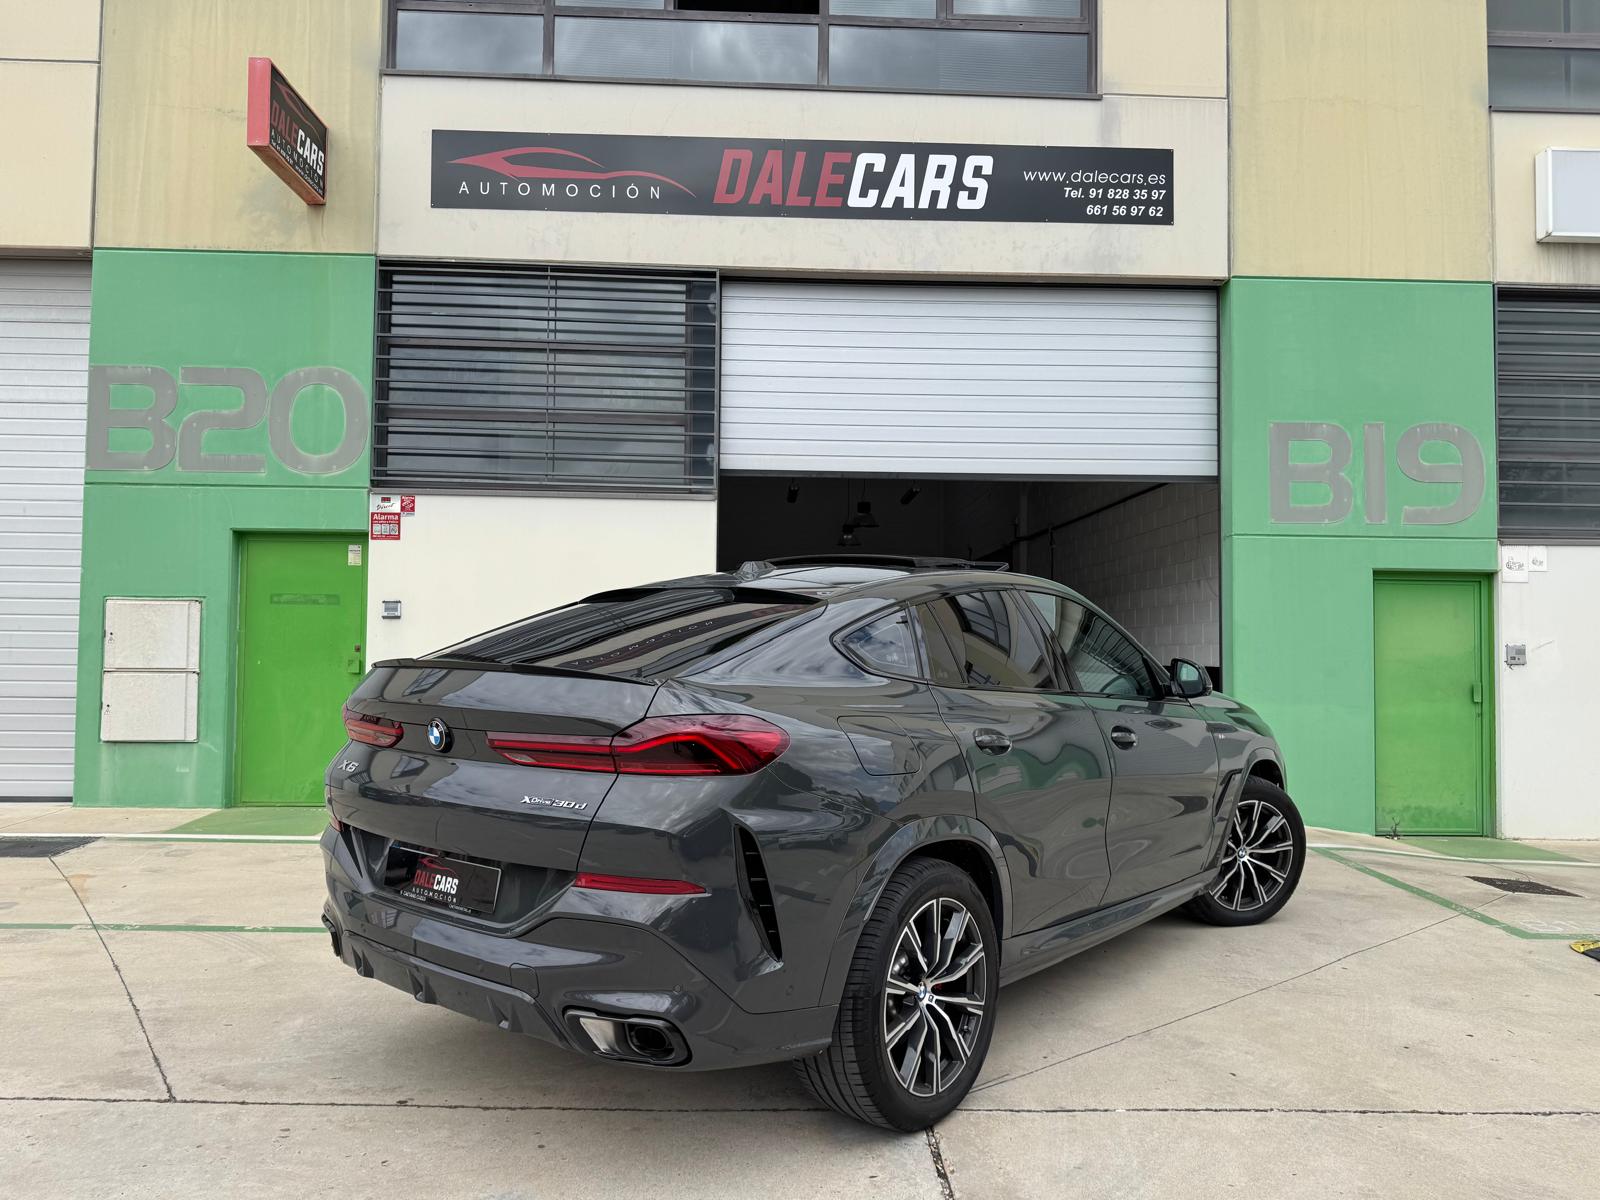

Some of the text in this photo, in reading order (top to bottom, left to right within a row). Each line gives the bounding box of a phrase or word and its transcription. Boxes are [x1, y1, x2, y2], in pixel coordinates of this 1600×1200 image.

[271, 100, 325, 177] DALECARS
[712, 148, 994, 210] DALECARS
[1023, 169, 1166, 186] www.dalecars.es
[458, 181, 661, 200] AUTOMOCIÓN
[1064, 187, 1166, 200] Tel. 91 828 35 97
[1086, 205, 1164, 217] 661 56 97 62
[85, 365, 369, 475] B20
[1268, 421, 1486, 525] B19
[337, 759, 360, 772] X6
[414, 870, 459, 894] DALECARS
